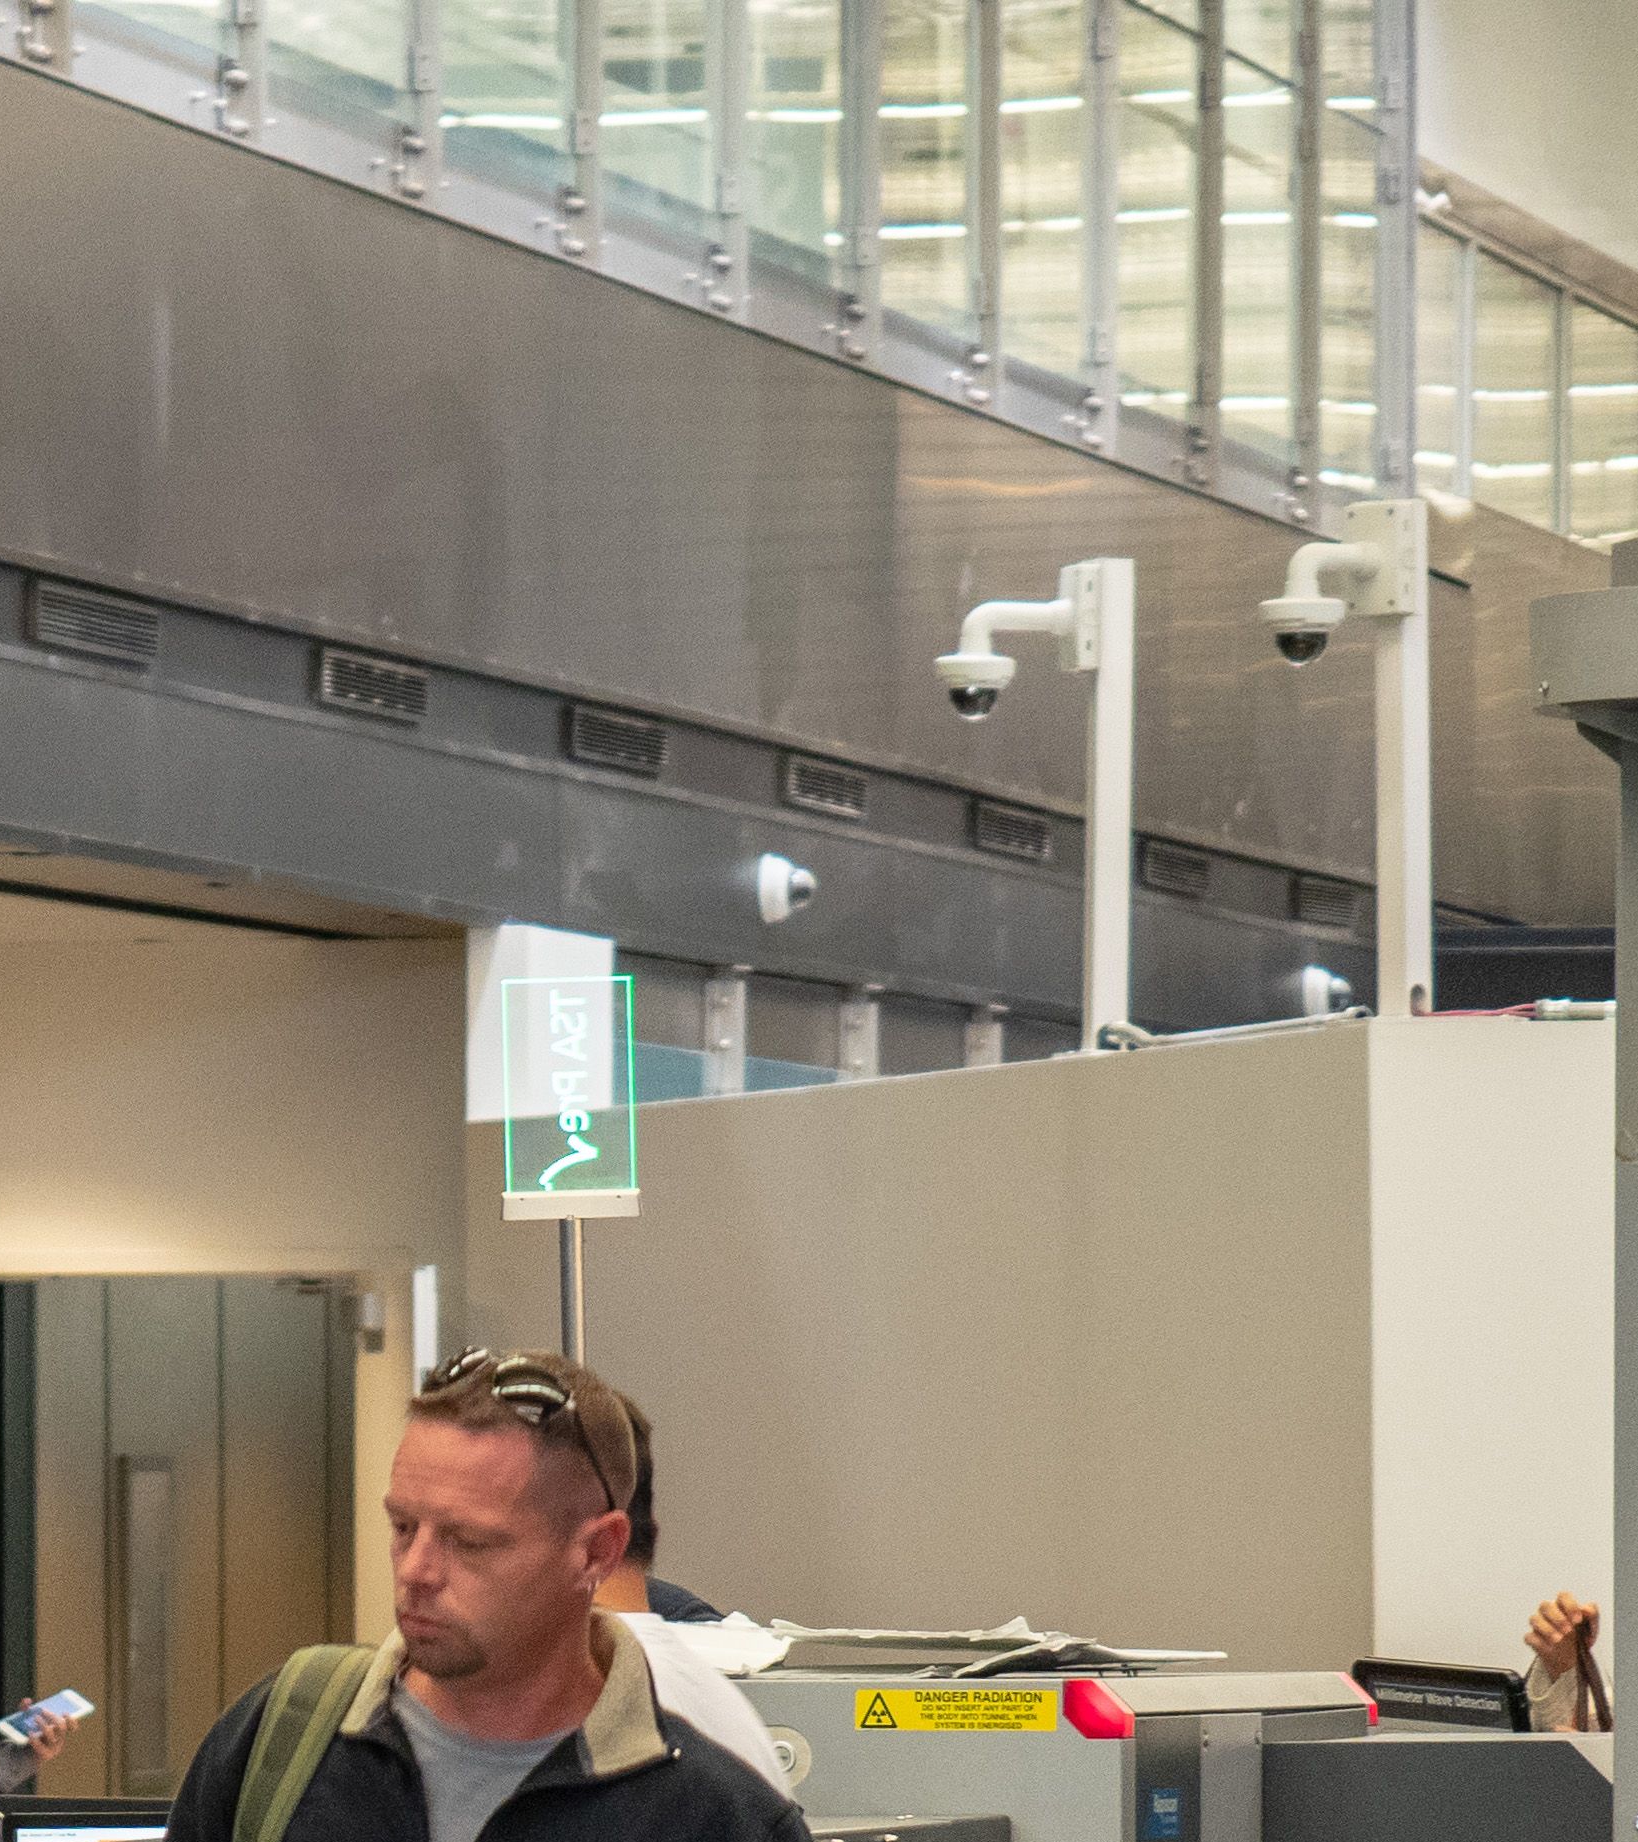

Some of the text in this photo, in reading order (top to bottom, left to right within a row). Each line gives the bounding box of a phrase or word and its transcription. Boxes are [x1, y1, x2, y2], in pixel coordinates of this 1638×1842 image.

[914, 1691, 1043, 1703] DANGER RADIATION
[922, 1704, 1035, 1712] DO NOT INSERT ANY PART OF
[981, 1713, 1012, 1721] TUNNEL
[1014, 1713, 1038, 1721] WHEN
